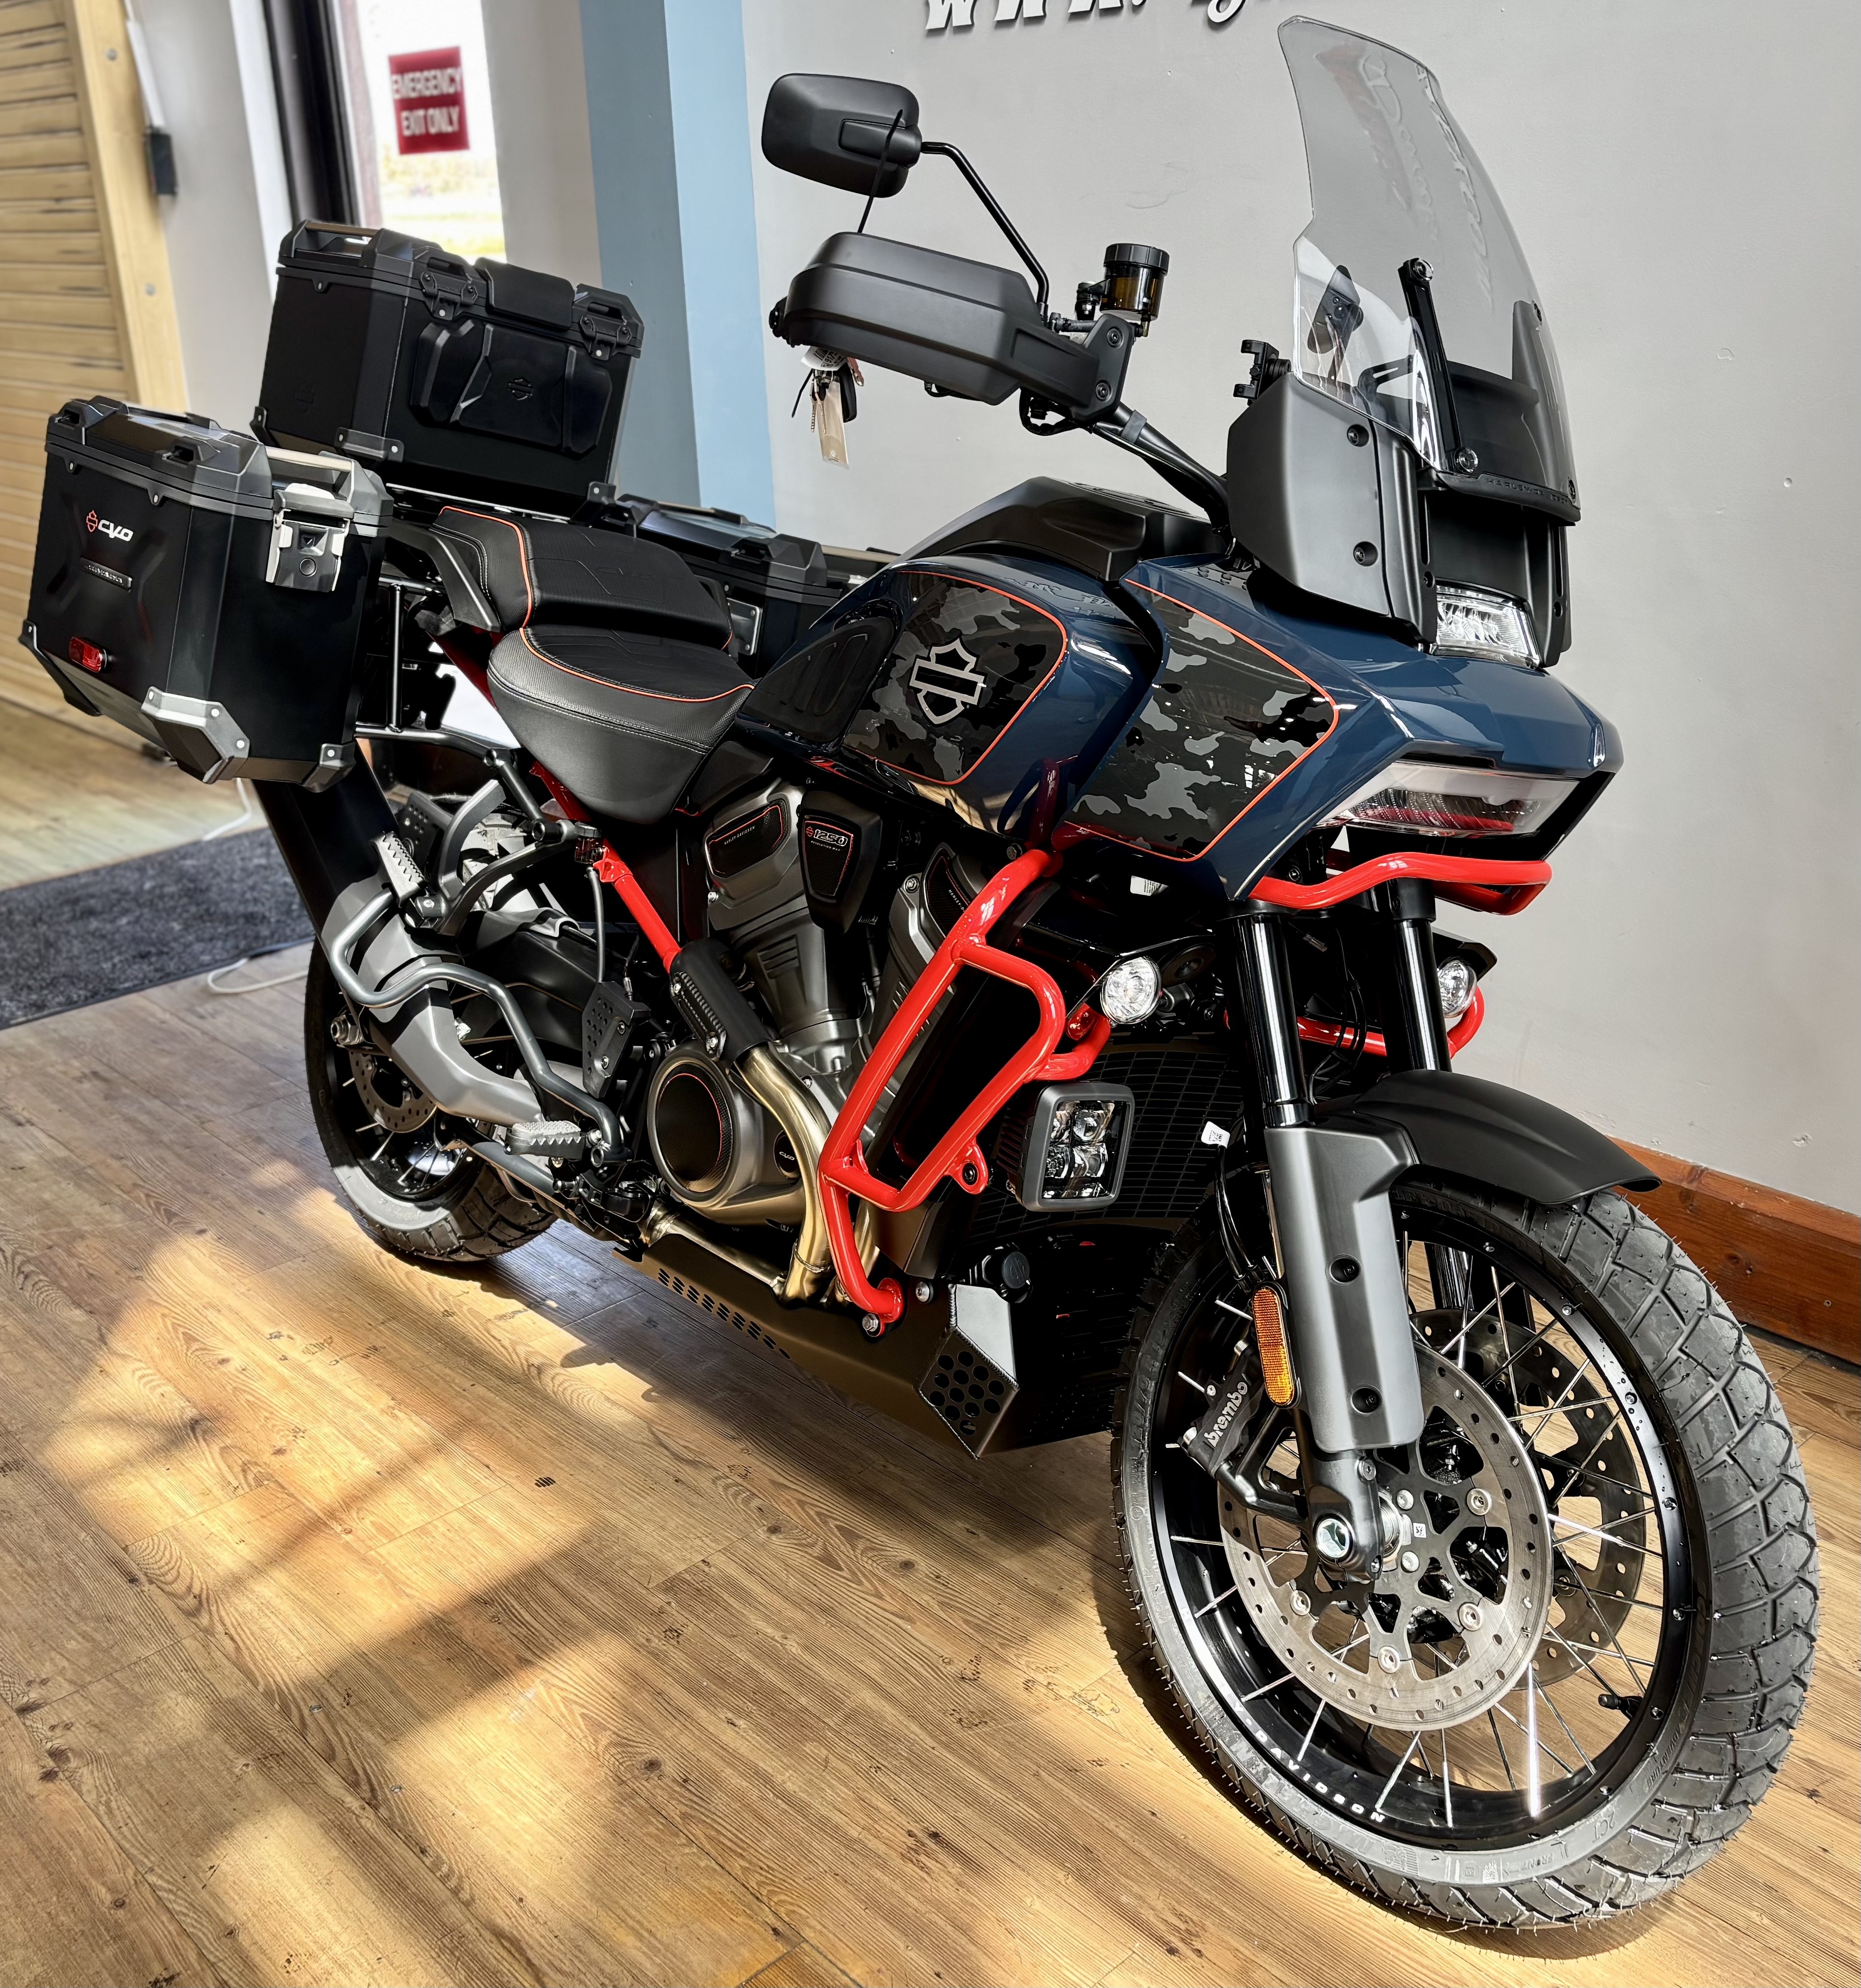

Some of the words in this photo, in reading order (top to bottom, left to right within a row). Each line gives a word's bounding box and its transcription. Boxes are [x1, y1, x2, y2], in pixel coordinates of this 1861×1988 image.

[391, 67, 463, 99] EMERGENCY
[401, 109, 426, 136] EXIT
[427, 105, 460, 134] ONLY
[814, 829, 848, 847] 1250
[948, 889, 965, 912] HARLEY-D
[1204, 1381, 1248, 1447] brembo
